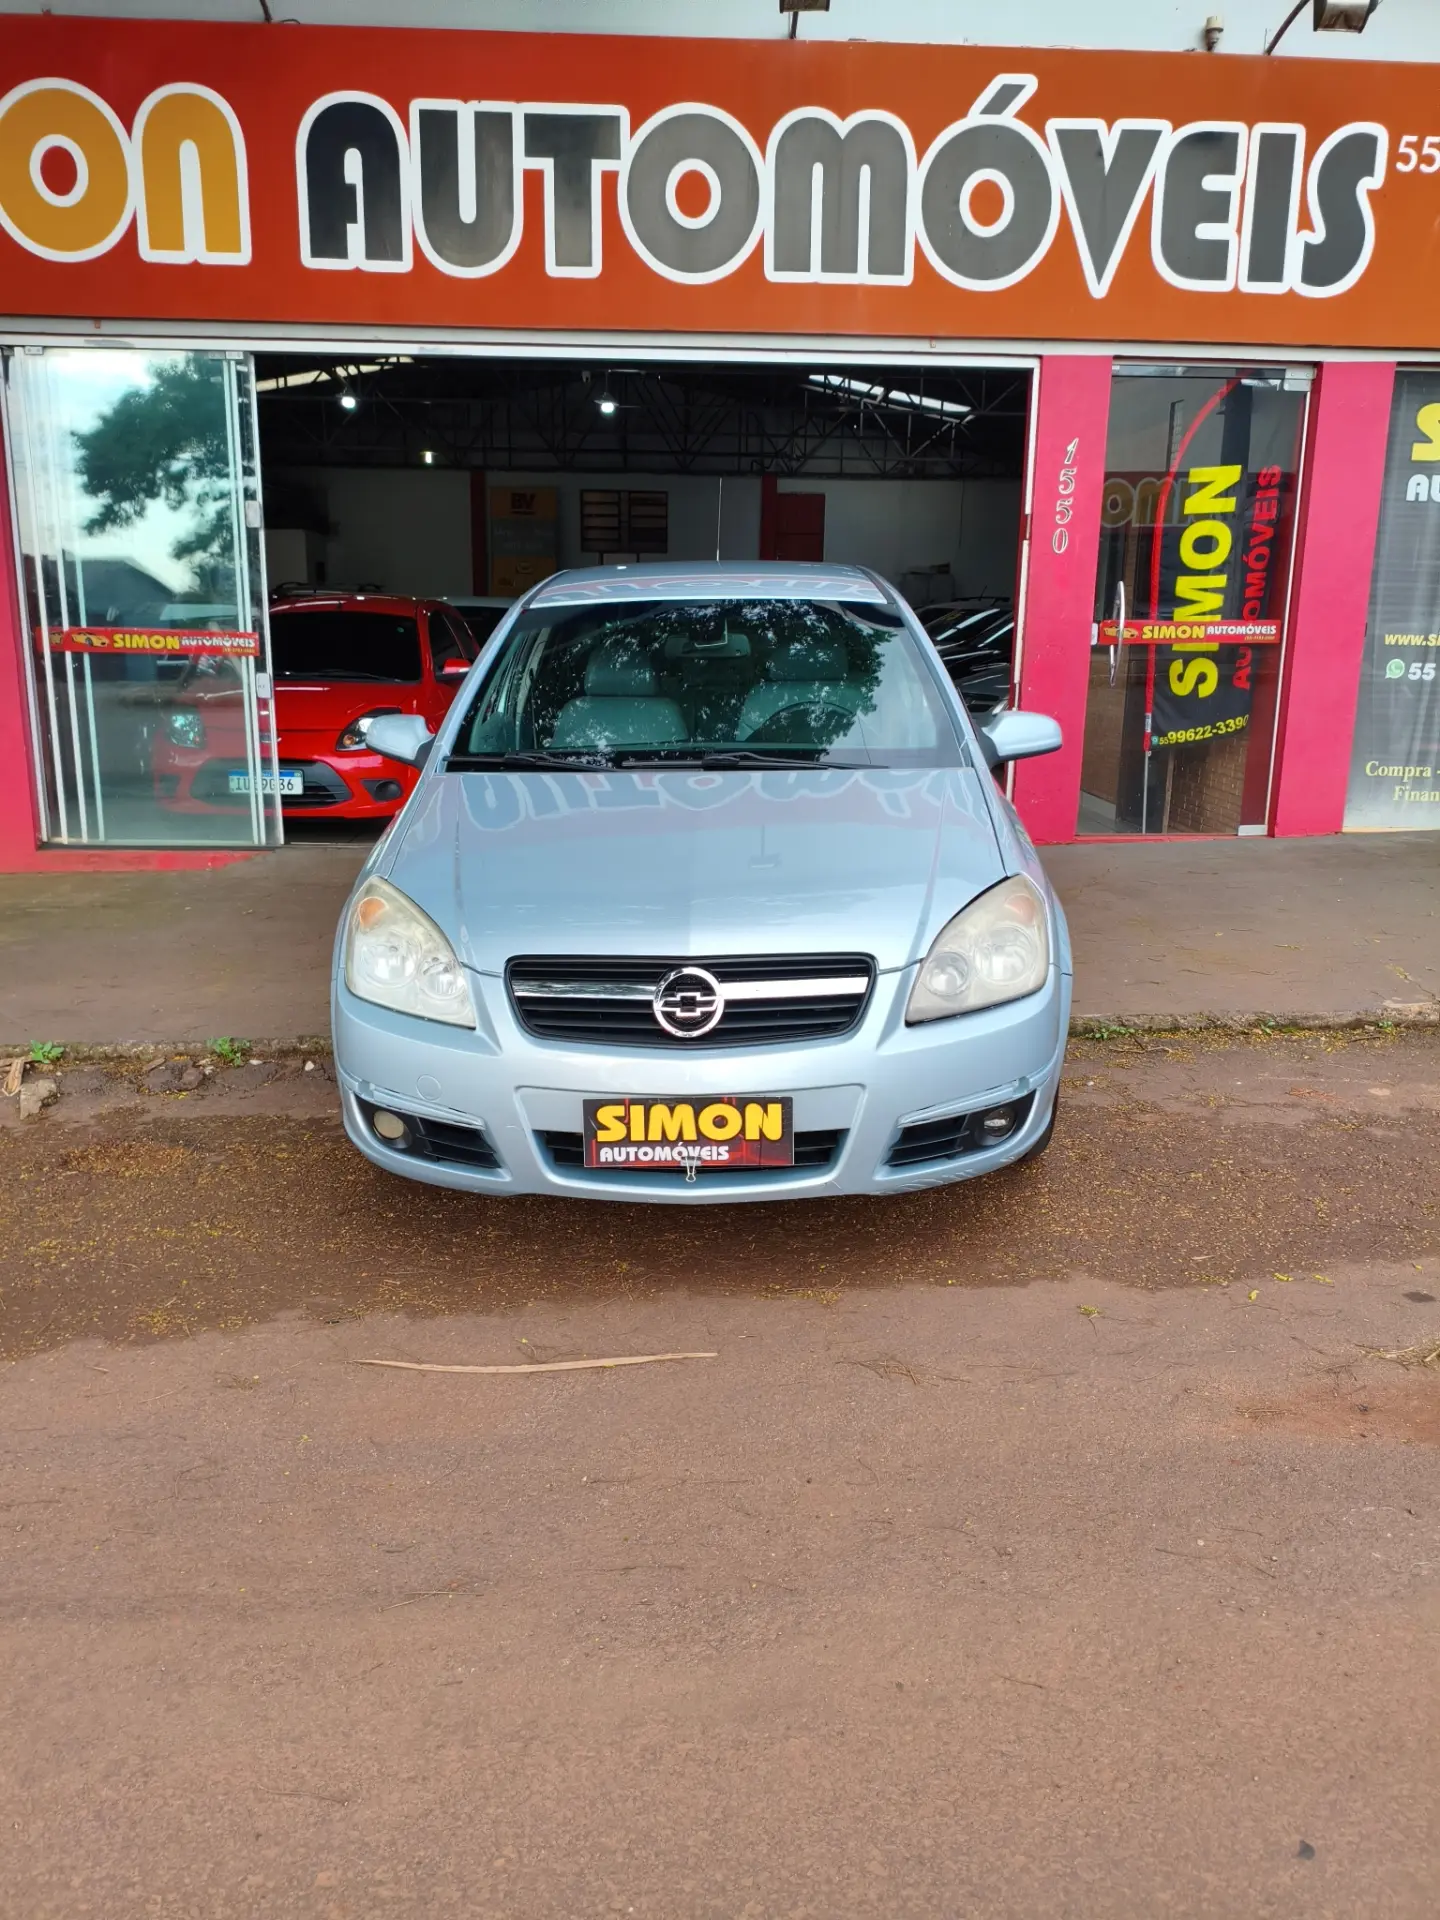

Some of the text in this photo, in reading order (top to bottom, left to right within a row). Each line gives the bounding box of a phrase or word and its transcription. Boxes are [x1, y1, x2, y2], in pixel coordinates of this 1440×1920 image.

[296, 73, 1388, 298] AUTOMÓVEIS
[1052, 437, 1079, 554] 1550
[1232, 464, 1282, 690] AUOMÓVEIS
[113, 633, 256, 650] SIMON AUTOMÓVEIS
[1142, 623, 1277, 640] SIMON AUTOMÓVEIS
[1408, 662, 1437, 681] 55
[1365, 760, 1432, 782] Compra
[596, 1103, 782, 1142] SIMON
[600, 1142, 730, 1162] AUTOMÓVEIS
